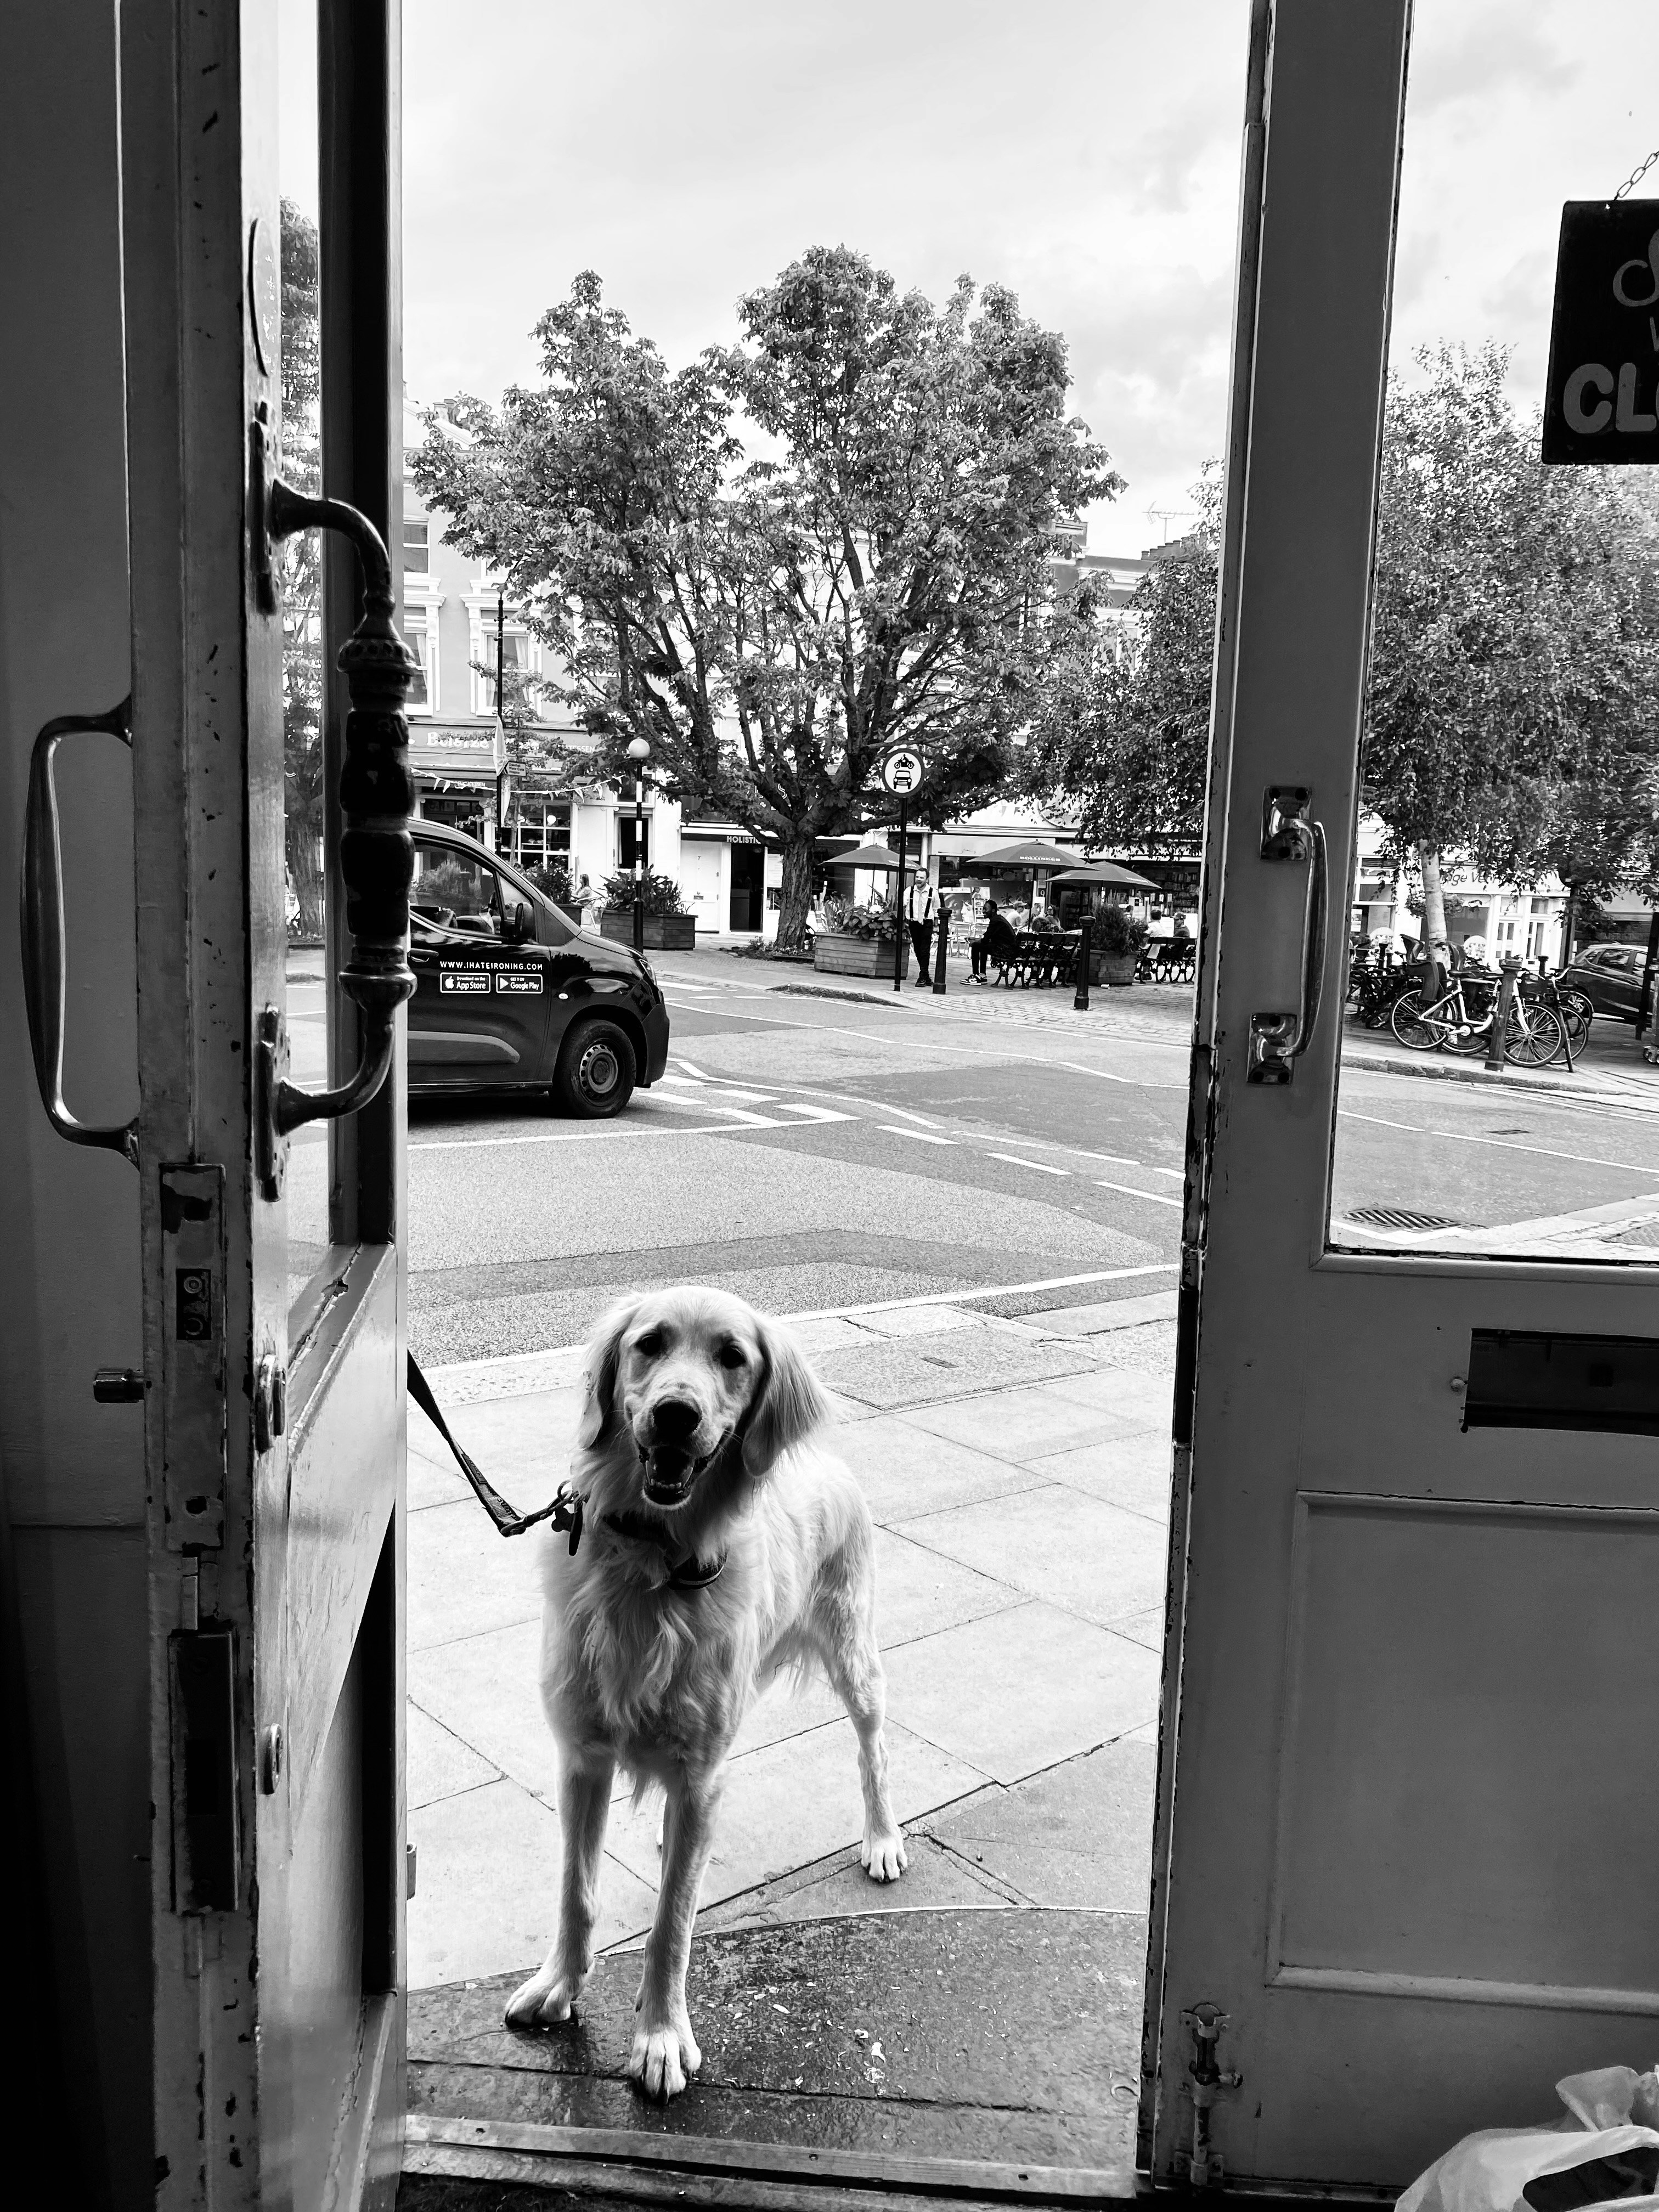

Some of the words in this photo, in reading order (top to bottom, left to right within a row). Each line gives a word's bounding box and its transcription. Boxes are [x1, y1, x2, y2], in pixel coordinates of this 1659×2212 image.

[1563, 362, 1659, 434] CL
[439, 961, 543, 970] WWW.IHATEIRONING.COM
[456, 981, 470, 991] App
[470, 981, 486, 989] Store
[510, 981, 529, 991] Google
[529, 981, 540, 991] Play
